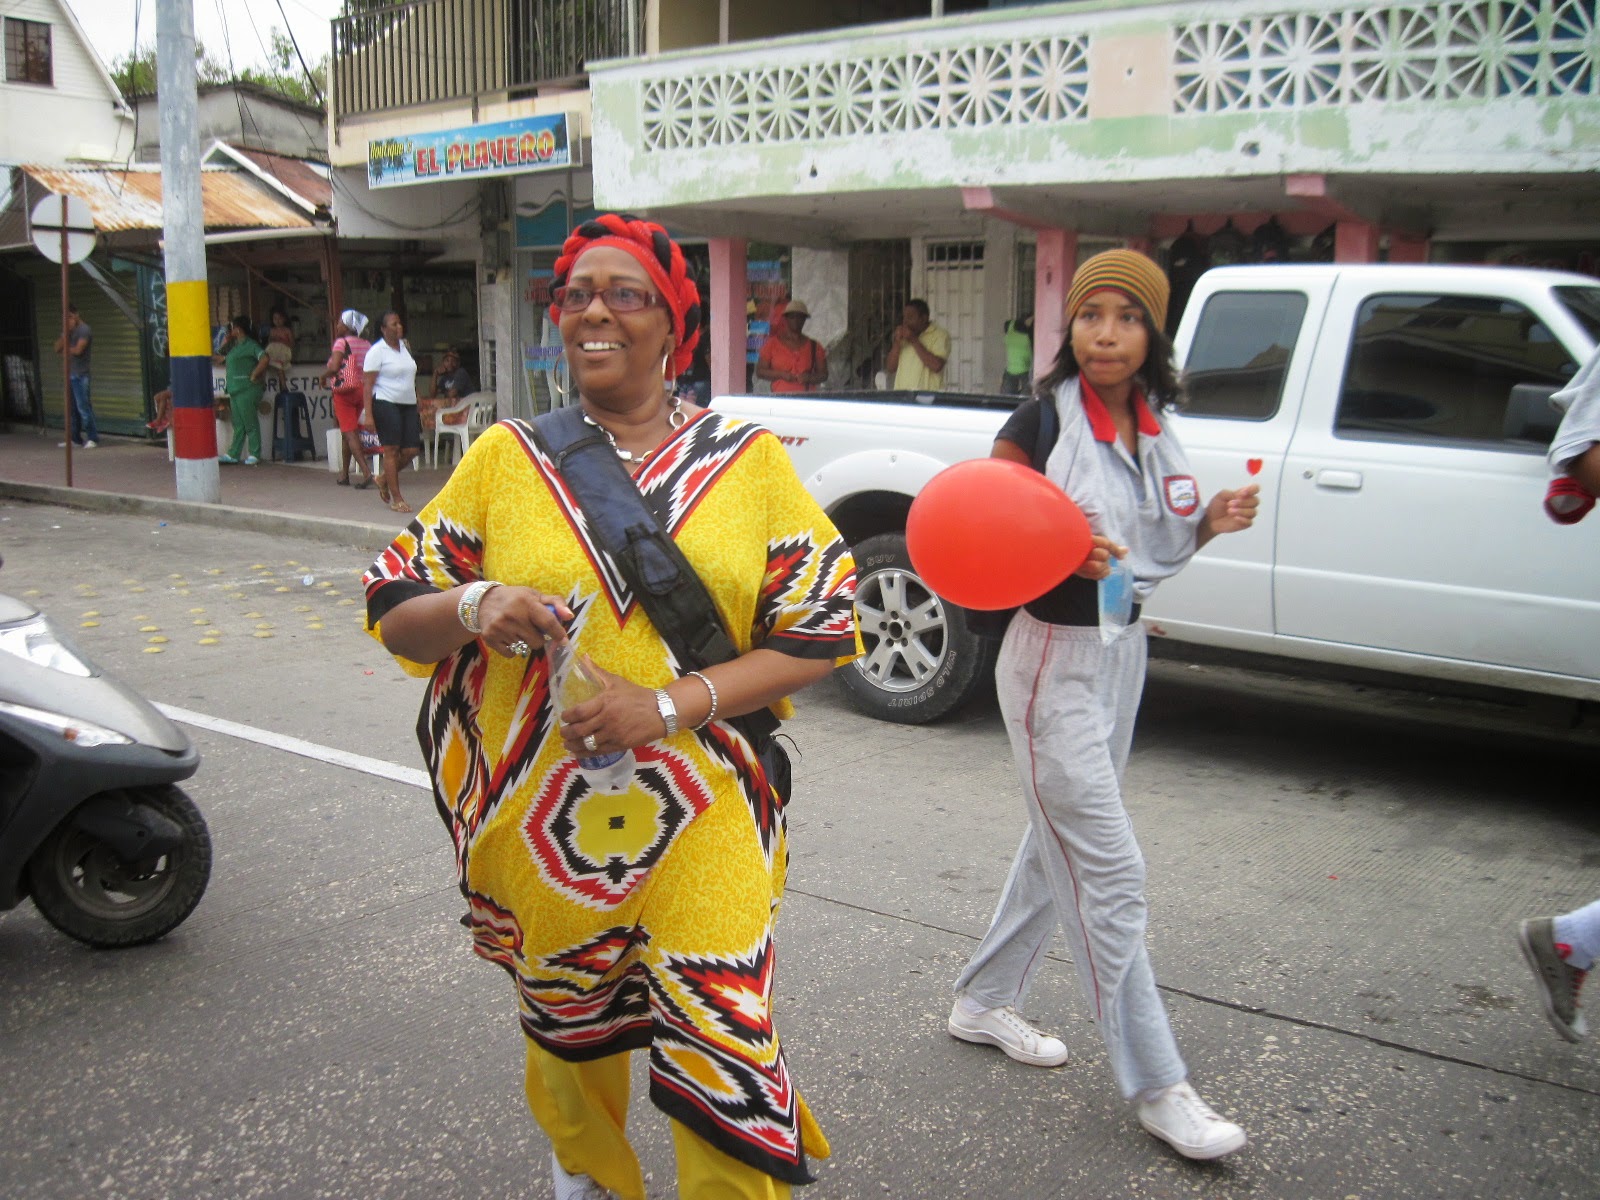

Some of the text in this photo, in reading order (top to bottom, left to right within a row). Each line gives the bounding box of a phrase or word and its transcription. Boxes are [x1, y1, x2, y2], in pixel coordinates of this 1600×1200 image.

[414, 129, 555, 175] EL PLAYERO
[776, 434, 809, 447] RT
[866, 554, 896, 567] SUV
[887, 650, 957, 708] WILD SPIRIT
